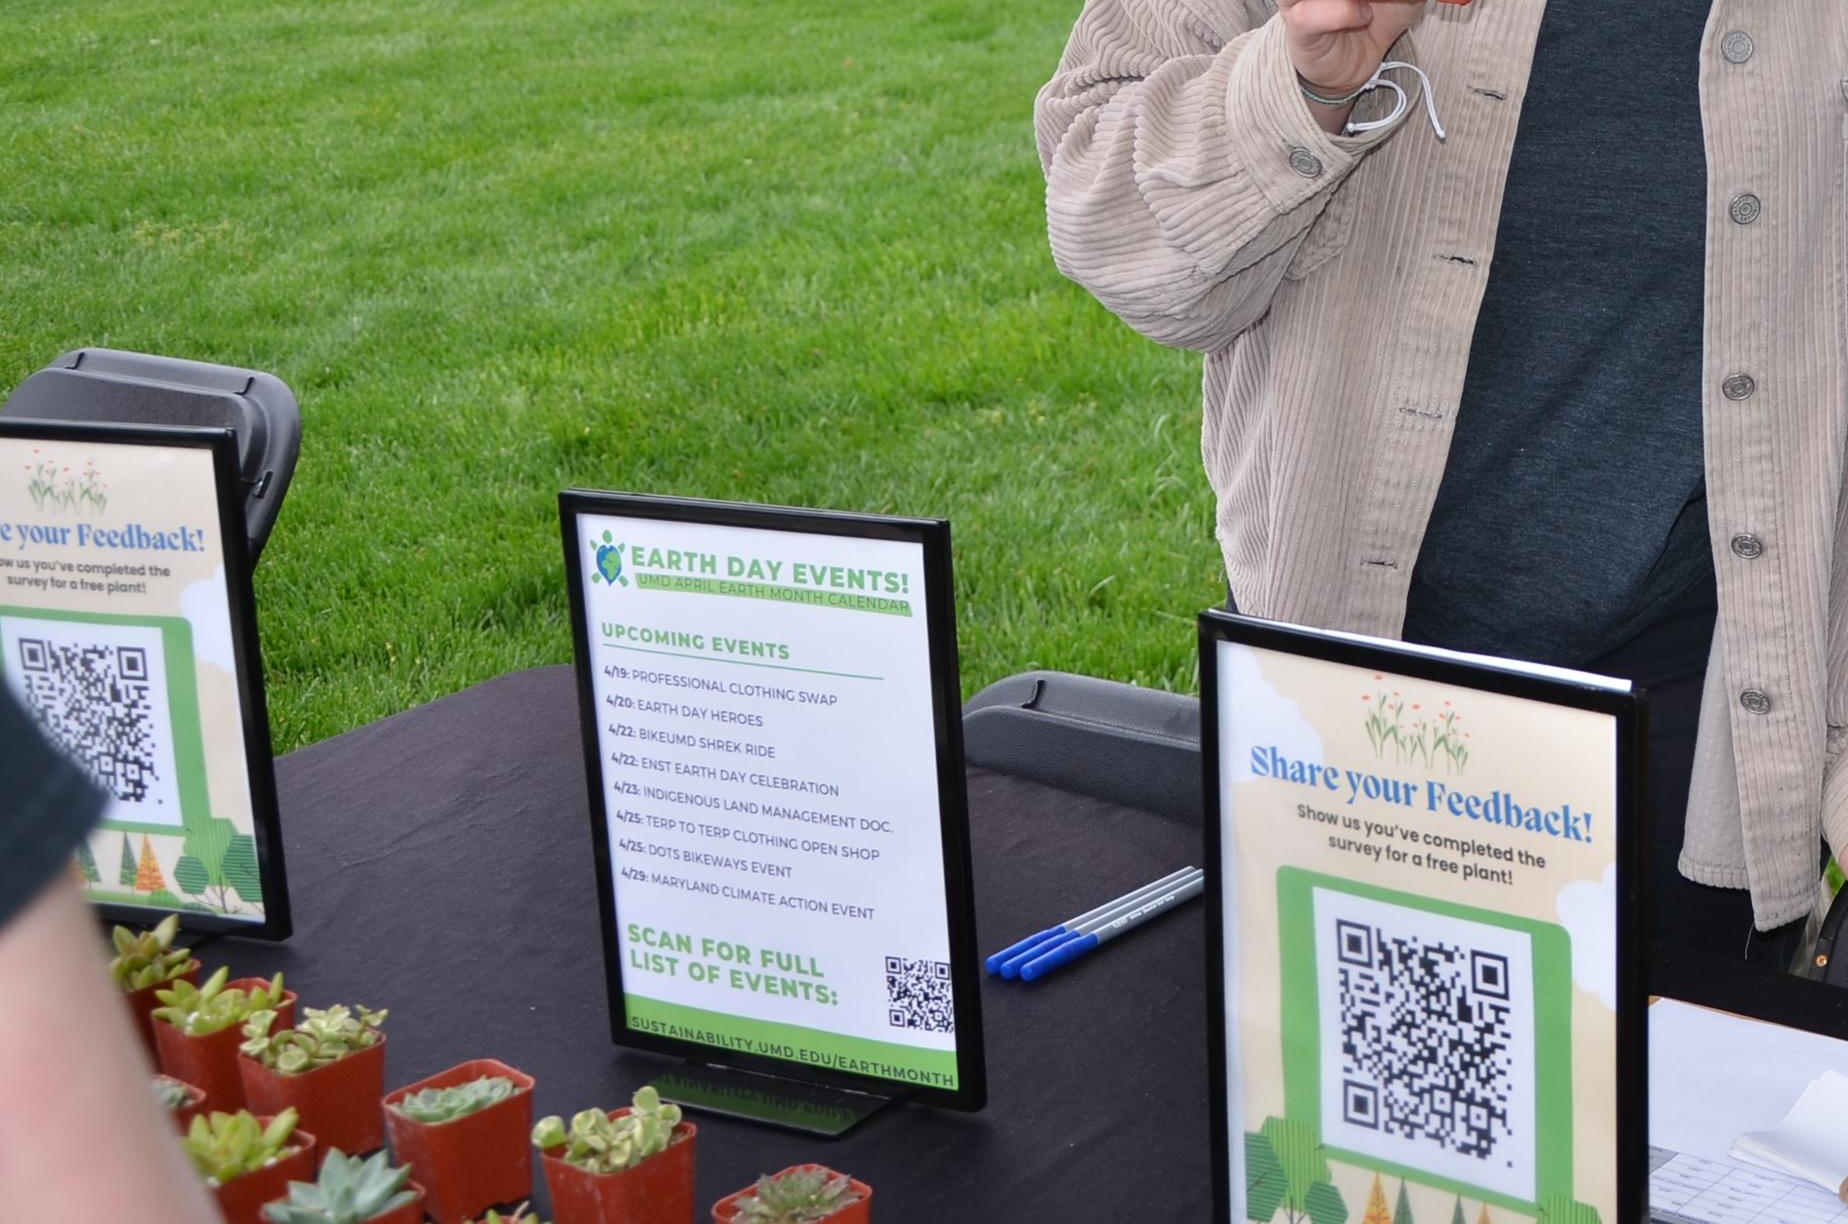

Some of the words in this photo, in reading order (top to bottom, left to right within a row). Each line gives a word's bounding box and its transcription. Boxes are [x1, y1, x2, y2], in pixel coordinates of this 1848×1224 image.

[16, 524, 71, 551] your
[77, 522, 205, 552] Feedback!
[7, 575, 48, 591] survey
[50, 576, 67, 588] for
[69, 579, 78, 590] a
[80, 577, 104, 591] free
[107, 580, 147, 596] plant!
[16, 559, 31, 569] us
[76, 562, 147, 579] completed
[148, 564, 171, 577] the
[631, 545, 717, 575] EARTH
[727, 555, 783, 582] DAY
[792, 562, 909, 595] EVENTS!
[639, 573, 671, 588] UMD
[675, 576, 715, 594] APRIL
[719, 580, 765, 599] EARTH
[769, 585, 823, 605] MONTH
[827, 592, 909, 613] CALENDAR
[601, 621, 705, 651] UPCOMING
[712, 636, 790, 661] EVENTS
[604, 664, 630, 680] 4/19:
[632, 669, 727, 693] PROFESSIONAL
[729, 683, 796, 702] CLOTHING
[798, 691, 838, 706] SWAP
[606, 694, 635, 710] 4/20:
[638, 699, 679, 716] EARTH
[682, 705, 708, 720] DAY
[711, 710, 764, 727] HEROES
[608, 723, 636, 738] 4/22:
[639, 728, 696, 747] BIKEUMD
[699, 737, 743, 754] SHREK
[746, 743, 776, 759] RIDE
[611, 751, 639, 767] 4/22:
[642, 757, 672, 773] ENST
[675, 763, 717, 780] EARTH
[720, 769, 747, 785] DAY
[750, 773, 840, 797] CELEBRATION
[1251, 745, 1339, 792] Share
[1345, 767, 1418, 806] your
[1426, 779, 1593, 844] Feedback!
[613, 780, 641, 796] 4/23:
[643, 786, 720, 809] INDIGENOUS
[723, 799, 759, 815] LAND
[761, 804, 857, 829] MANAGEMENT
[860, 818, 894, 833] DOC.
[616, 810, 644, 825] 4/25:
[646, 815, 677, 830] TERP
[679, 821, 696, 834] TO
[698, 824, 731, 839] TERP
[733, 830, 798, 851] CLOTHING
[801, 840, 838, 856] OPEN
[841, 846, 880, 861] SHOP
[619, 838, 646, 854] 4/25:
[648, 844, 681, 861] DOTS
[683, 850, 748, 872] BIKEWAYS
[751, 861, 793, 879] EVENT
[1297, 803, 1338, 826] Show
[1342, 815, 1361, 831] us
[1423, 831, 1514, 859] completed
[1517, 849, 1546, 869] the
[1328, 836, 1381, 862] survey
[1385, 844, 1409, 863] for
[1412, 852, 1422, 867] a
[1426, 853, 1458, 874] free
[1462, 861, 1513, 886] plant!
[621, 867, 649, 883] 4/29:
[651, 873, 720, 896] MARYLAND
[722, 886, 776, 906] CLIMATE
[779, 895, 828, 914] ACTION
[831, 903, 875, 920] EVENT
[627, 923, 693, 955] SCAN
[701, 937, 752, 965] FOR
[760, 948, 826, 979] FULL
[630, 948, 680, 978] LIST
[687, 962, 721, 985] OF
[730, 966, 839, 1007] EVENTS:
[631, 1015, 956, 1088] SUSTAINABILITY.UMD.EDU/EARTHMONTH
